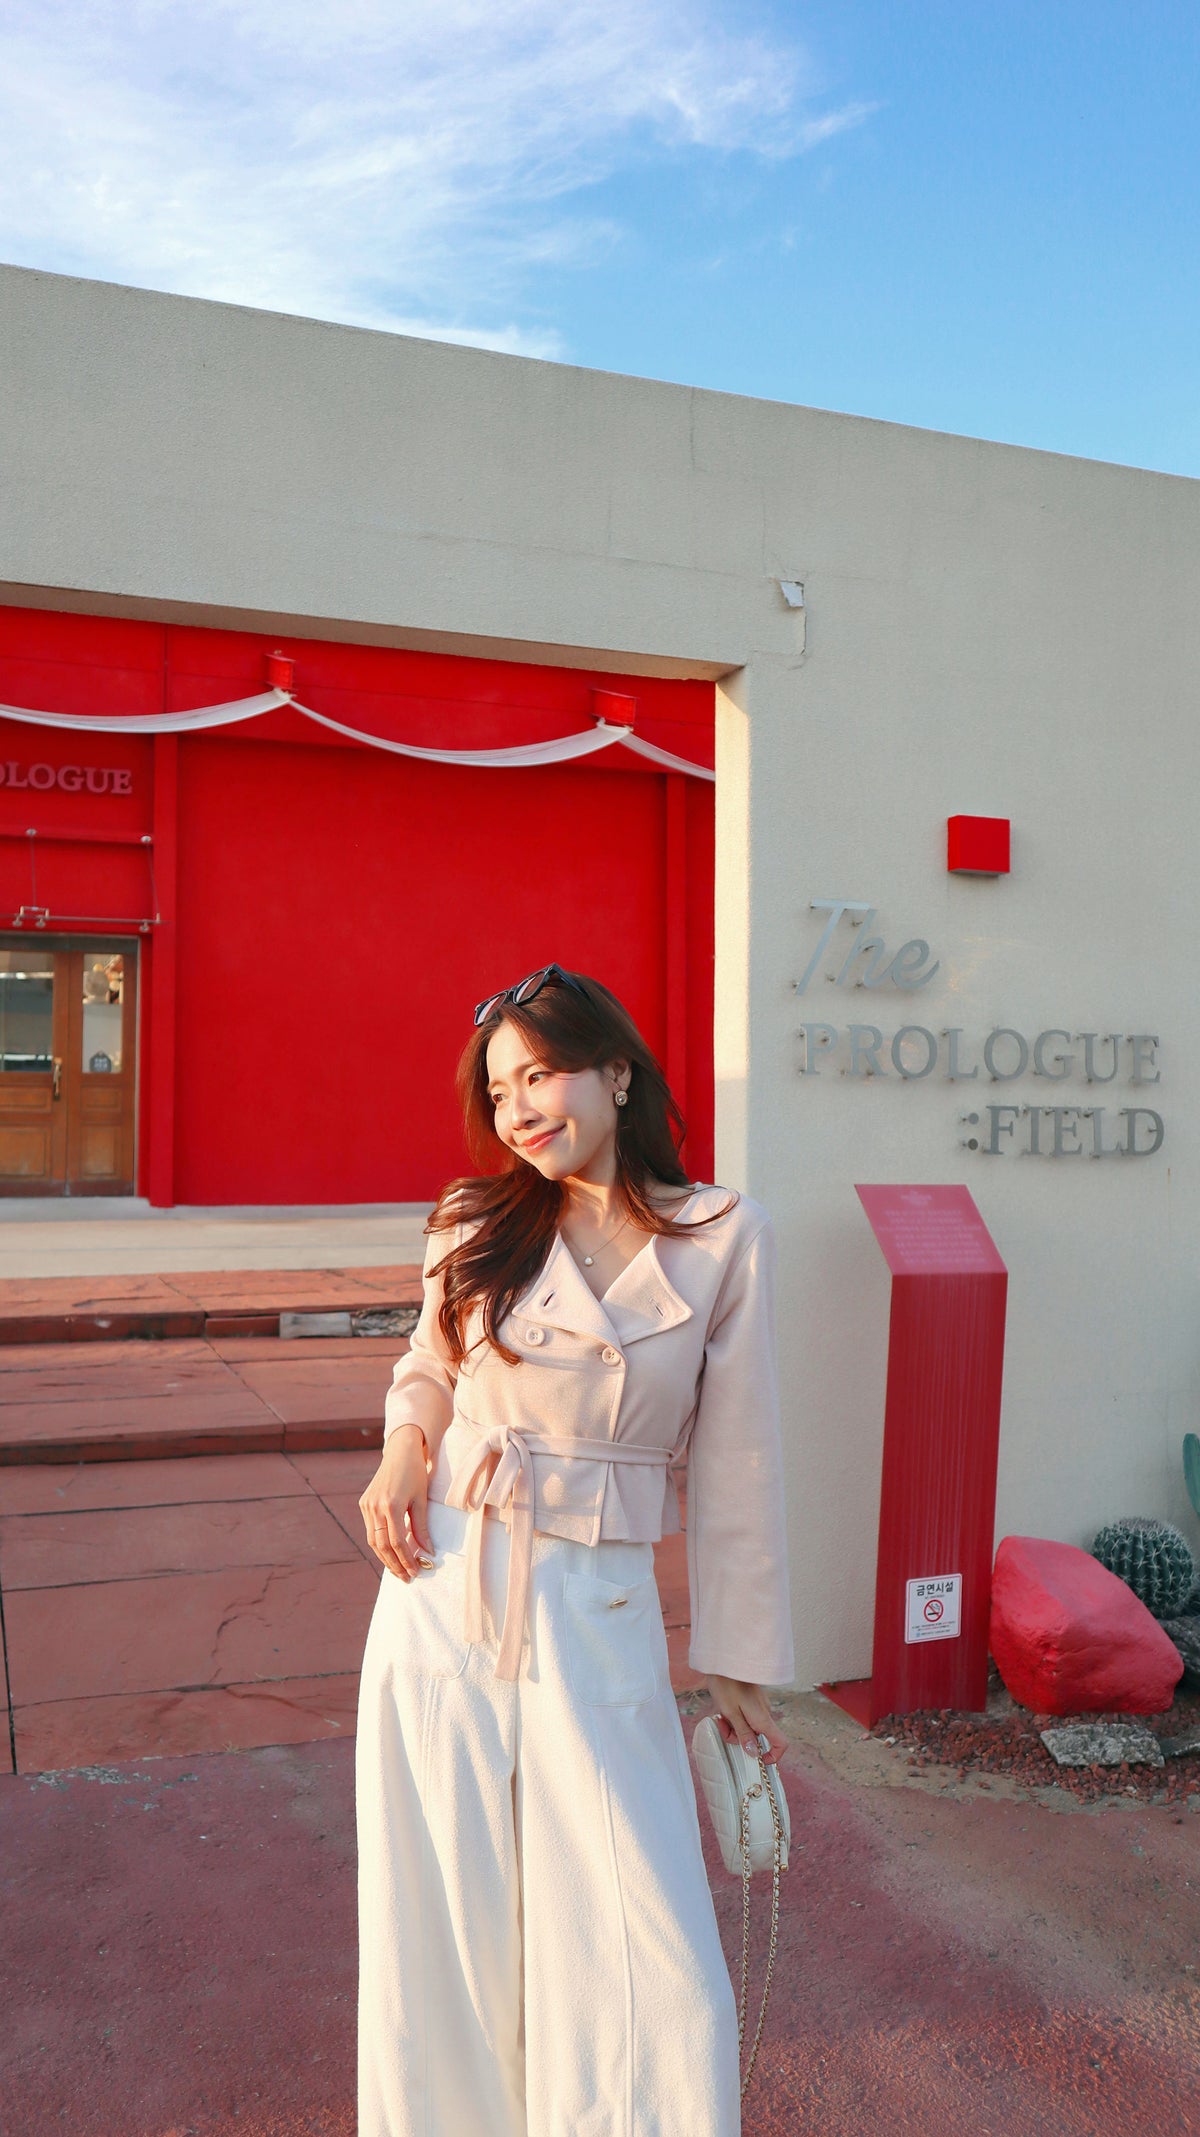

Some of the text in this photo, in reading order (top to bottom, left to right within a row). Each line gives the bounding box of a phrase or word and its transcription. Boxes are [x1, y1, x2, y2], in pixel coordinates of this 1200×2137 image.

[0, 762, 133, 795] LOGUE
[795, 899, 940, 996] The
[800, 1022, 1161, 1083] PROLOGUE
[916, 1581, 954, 1597] 금연시설
